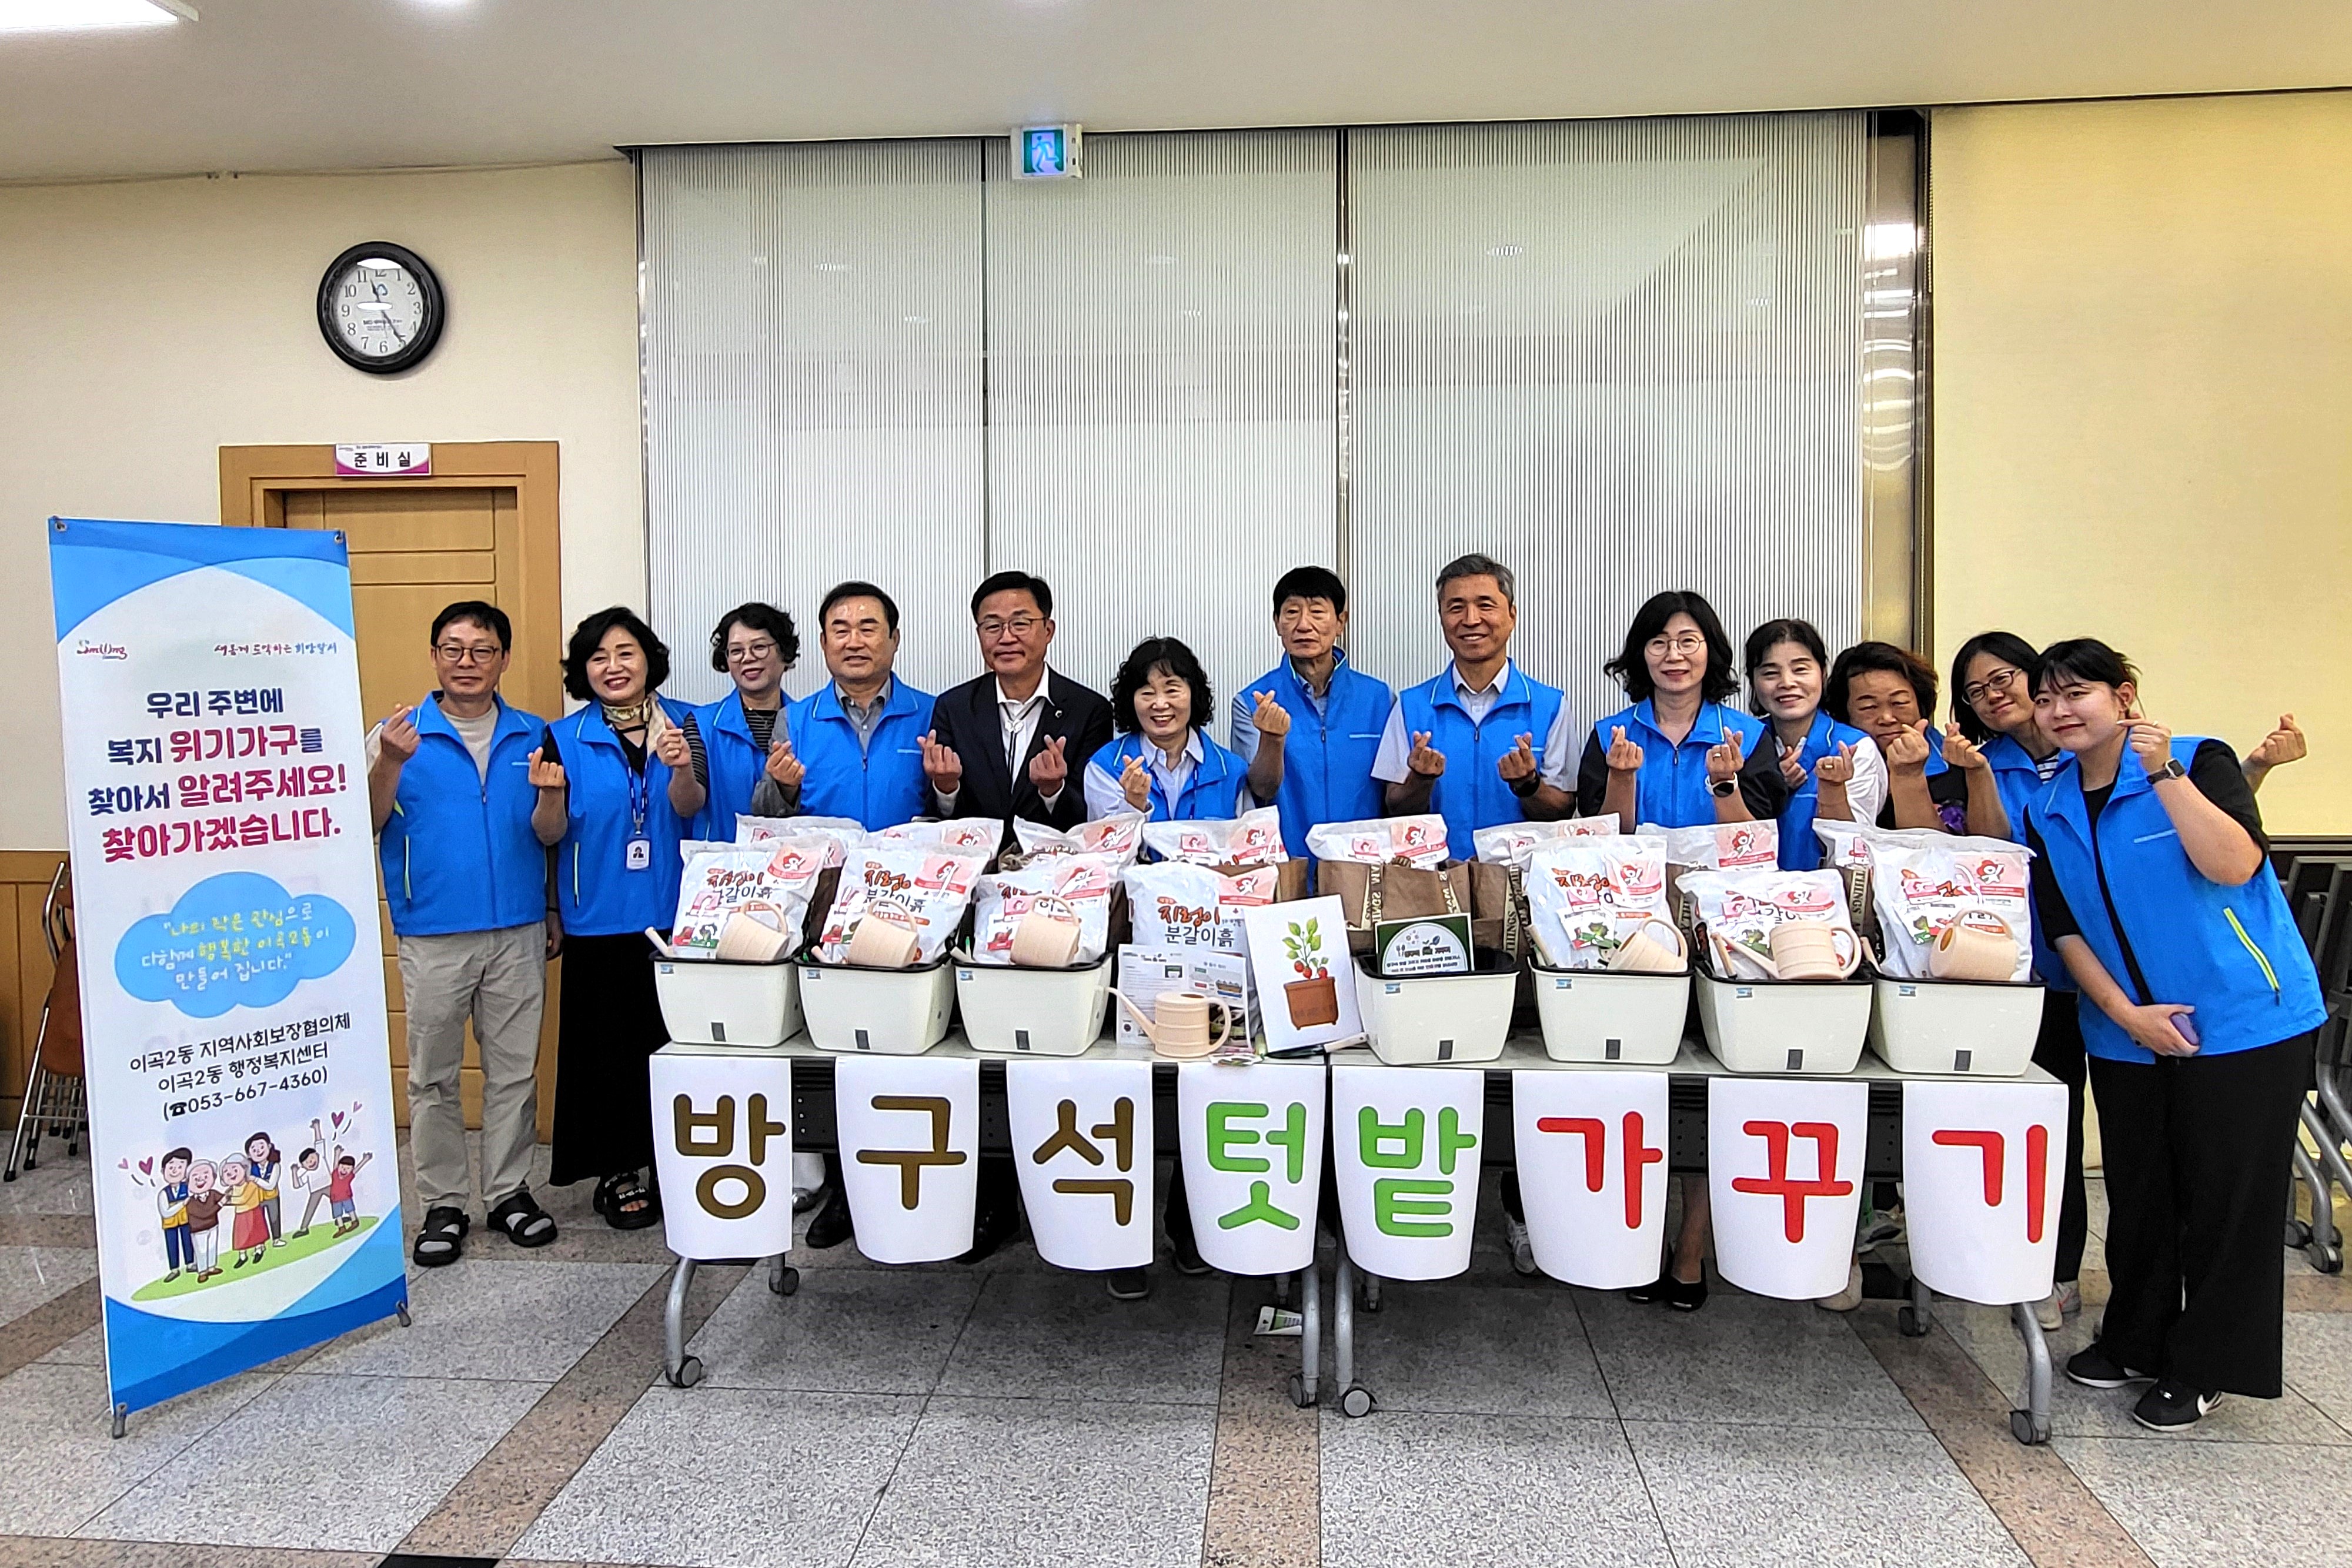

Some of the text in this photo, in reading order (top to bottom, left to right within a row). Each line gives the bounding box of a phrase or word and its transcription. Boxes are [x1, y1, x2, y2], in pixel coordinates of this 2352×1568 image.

[358, 270, 366, 282] 11
[345, 285, 356, 297] 10
[407, 282, 416, 295] 2
[342, 305, 350, 317] 9
[413, 302, 422, 314] 3
[348, 323, 356, 335] 8
[361, 337, 369, 349] 7
[379, 341, 388, 353] 6
[147, 688, 284, 718] 우리 주변에
[108, 724, 323, 764] 복지 위기가구를
[88, 764, 346, 815] 찾아서 알려주세요!
[102, 808, 341, 862] 찾아가겠습니다.
[1158, 905, 1221, 927] 지렁이
[1165, 925, 1234, 947] 분갈이흙
[142, 948, 194, 969] 다함께
[175, 967, 228, 991] 만들어
[130, 1012, 350, 1073] 이곡2동 지역사회보장협의체
[158, 1041, 328, 1093] 이곡2동 행정복지센터
